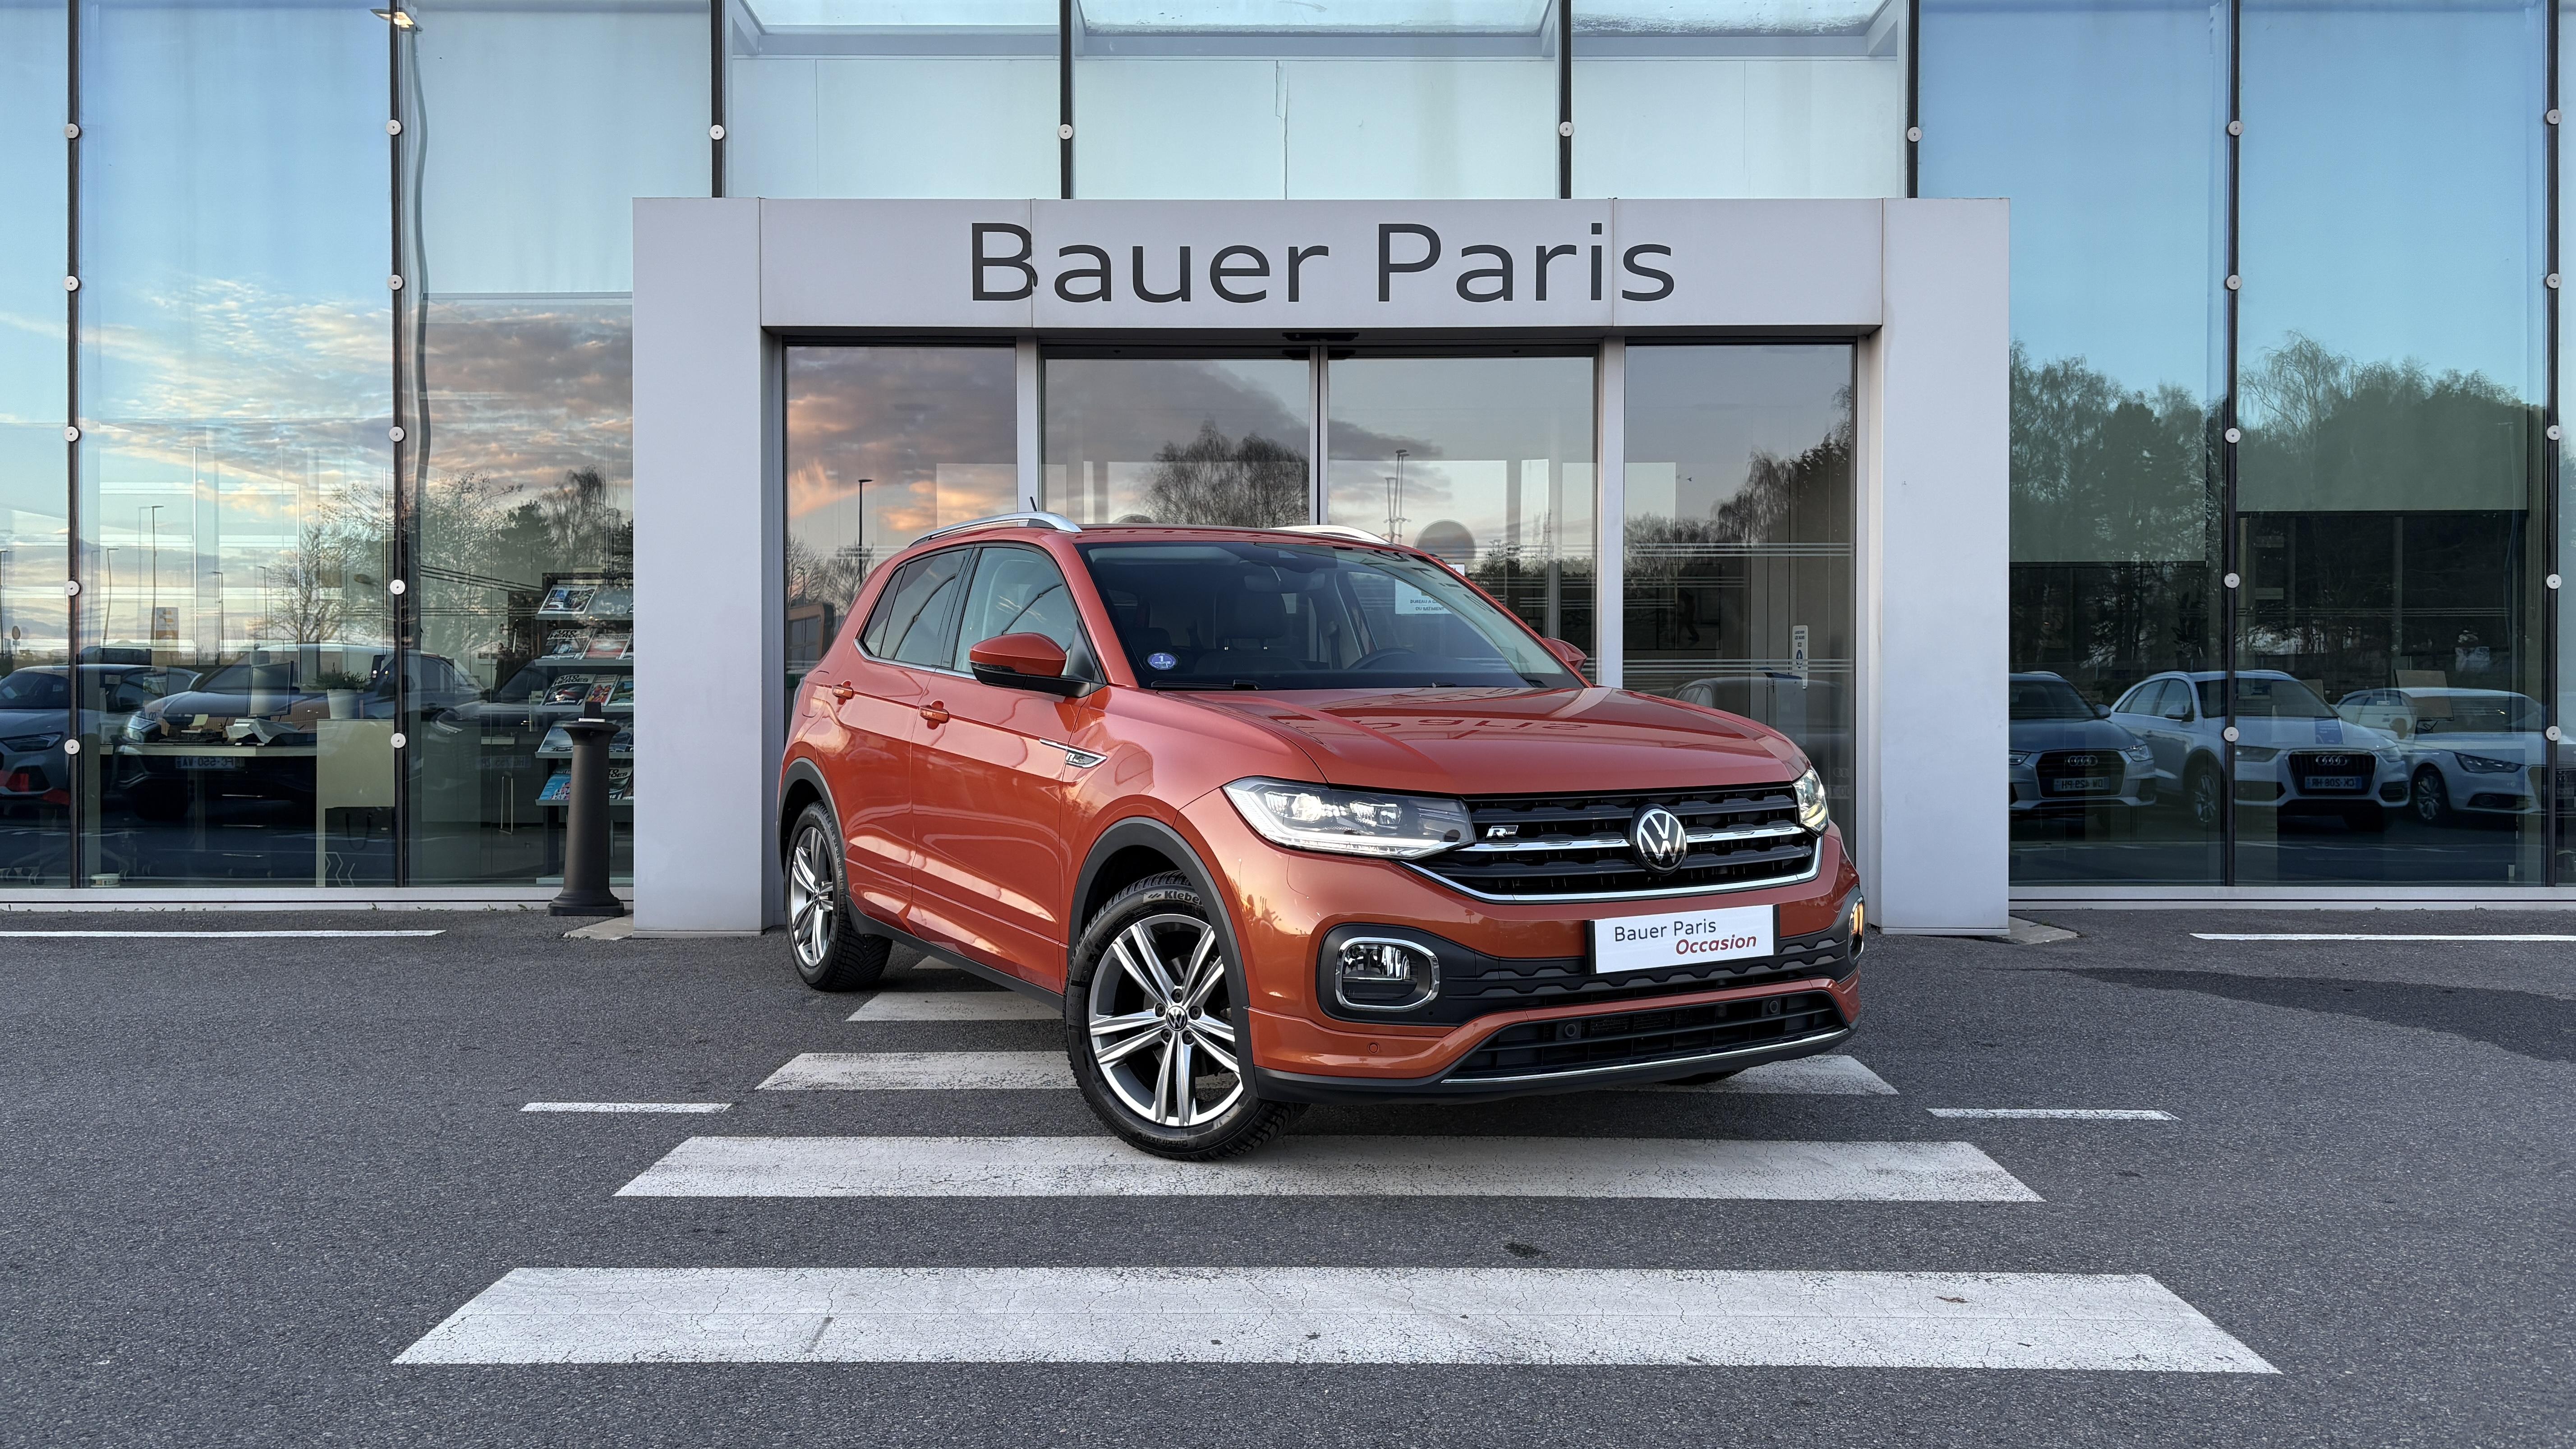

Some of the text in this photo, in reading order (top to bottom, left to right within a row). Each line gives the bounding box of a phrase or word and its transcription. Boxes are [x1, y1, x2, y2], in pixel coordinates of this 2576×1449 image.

[972, 223, 1674, 303] Bauer Paris
[1615, 918, 1716, 942] Bauer Paris
[1675, 934, 1757, 959] Occasion
